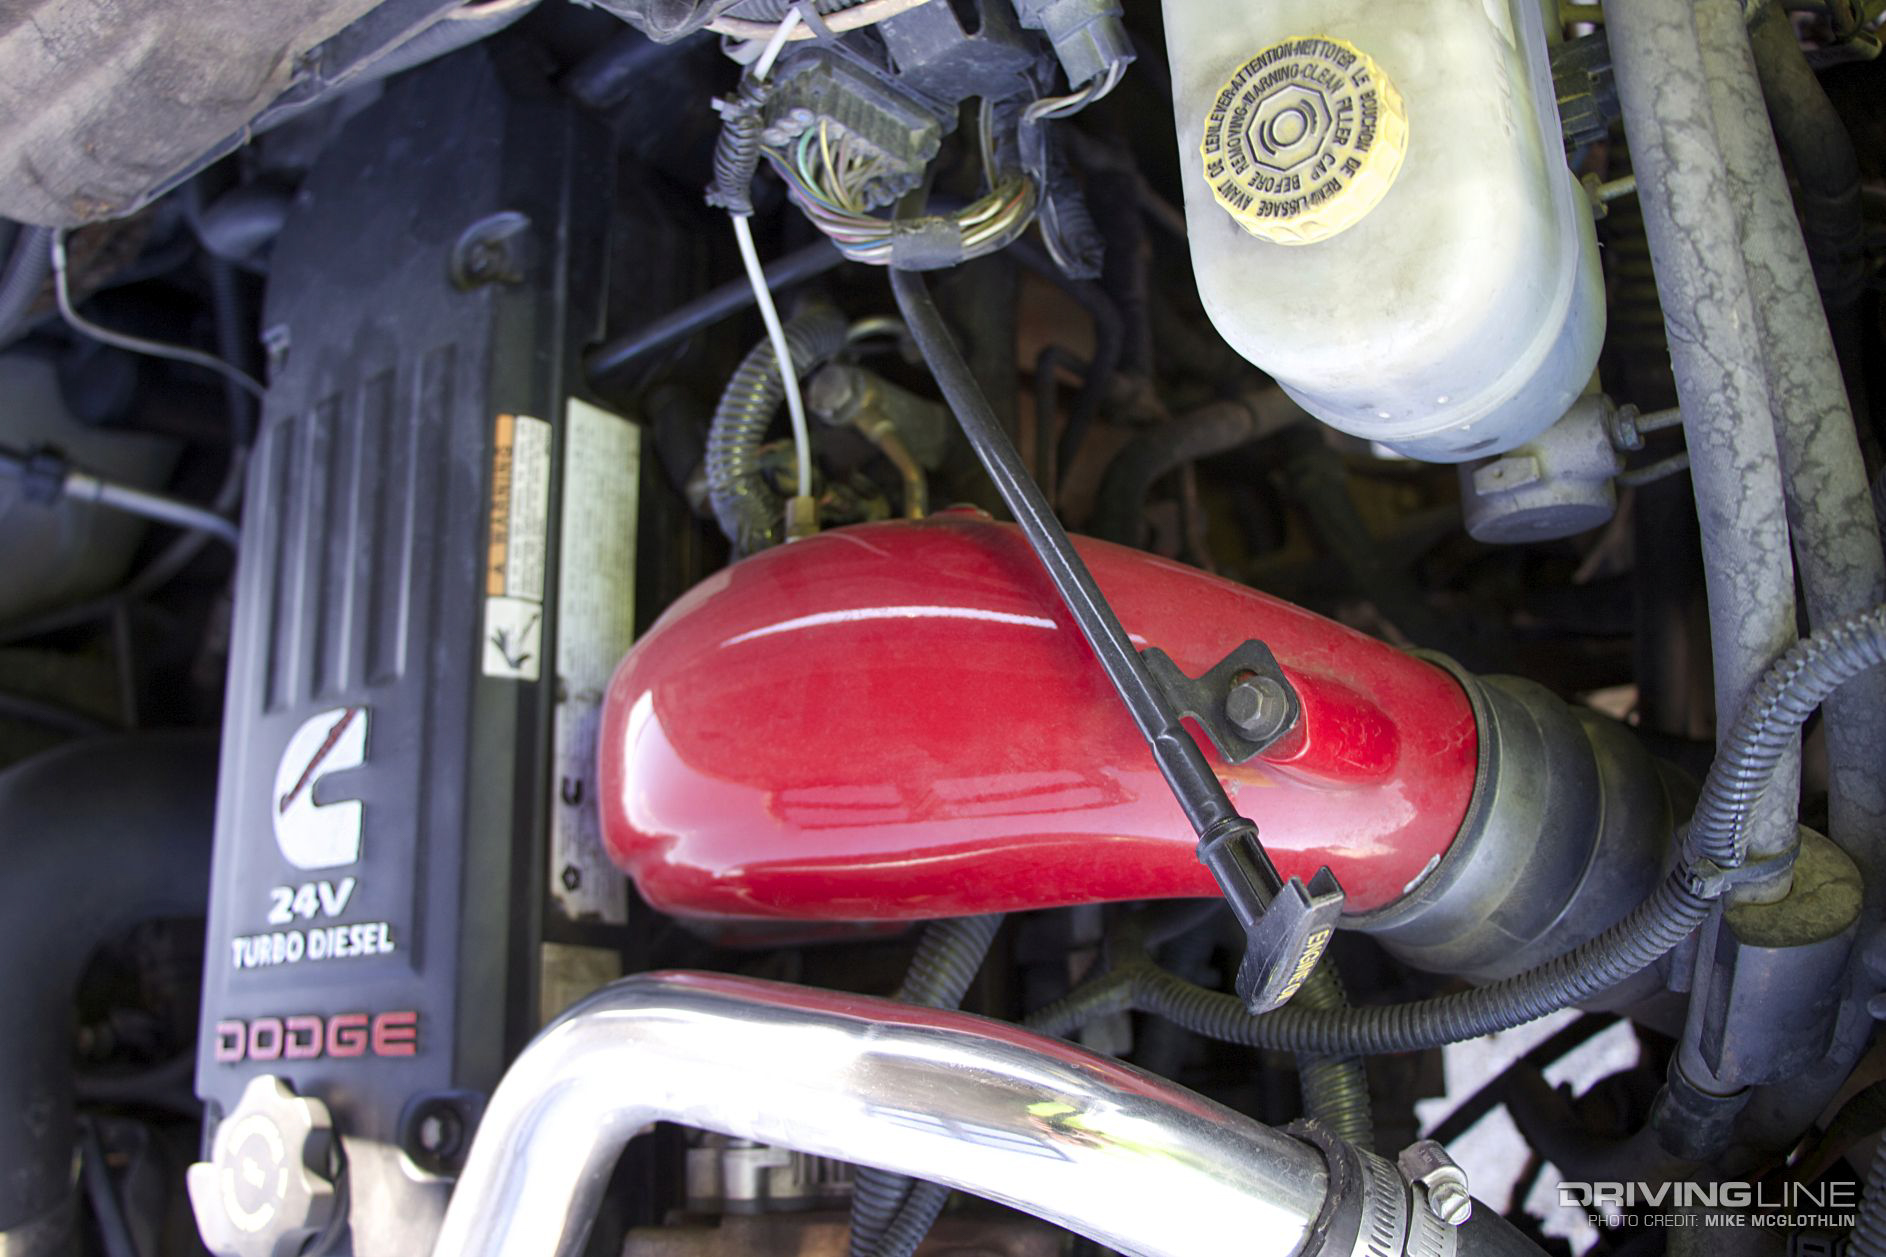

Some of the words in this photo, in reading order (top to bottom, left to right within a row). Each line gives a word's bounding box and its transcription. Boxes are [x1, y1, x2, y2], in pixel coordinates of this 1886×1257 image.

[1351, 67, 1370, 87] LE
[1333, 96, 1353, 146] FILLER
[1354, 89, 1378, 152] BOUCHON
[1207, 158, 1225, 178] DE
[1248, 171, 1301, 194] BEFORE
[1311, 152, 1336, 181] CAP
[1340, 156, 1362, 179] DE
[1217, 179, 1253, 211] AVANT
[267, 877, 356, 925] 24V
[232, 930, 305, 969] TURBO
[307, 922, 395, 960] DIESEL
[1287, 929, 1330, 985] ENGINE
[214, 1011, 417, 1062] DODGE
